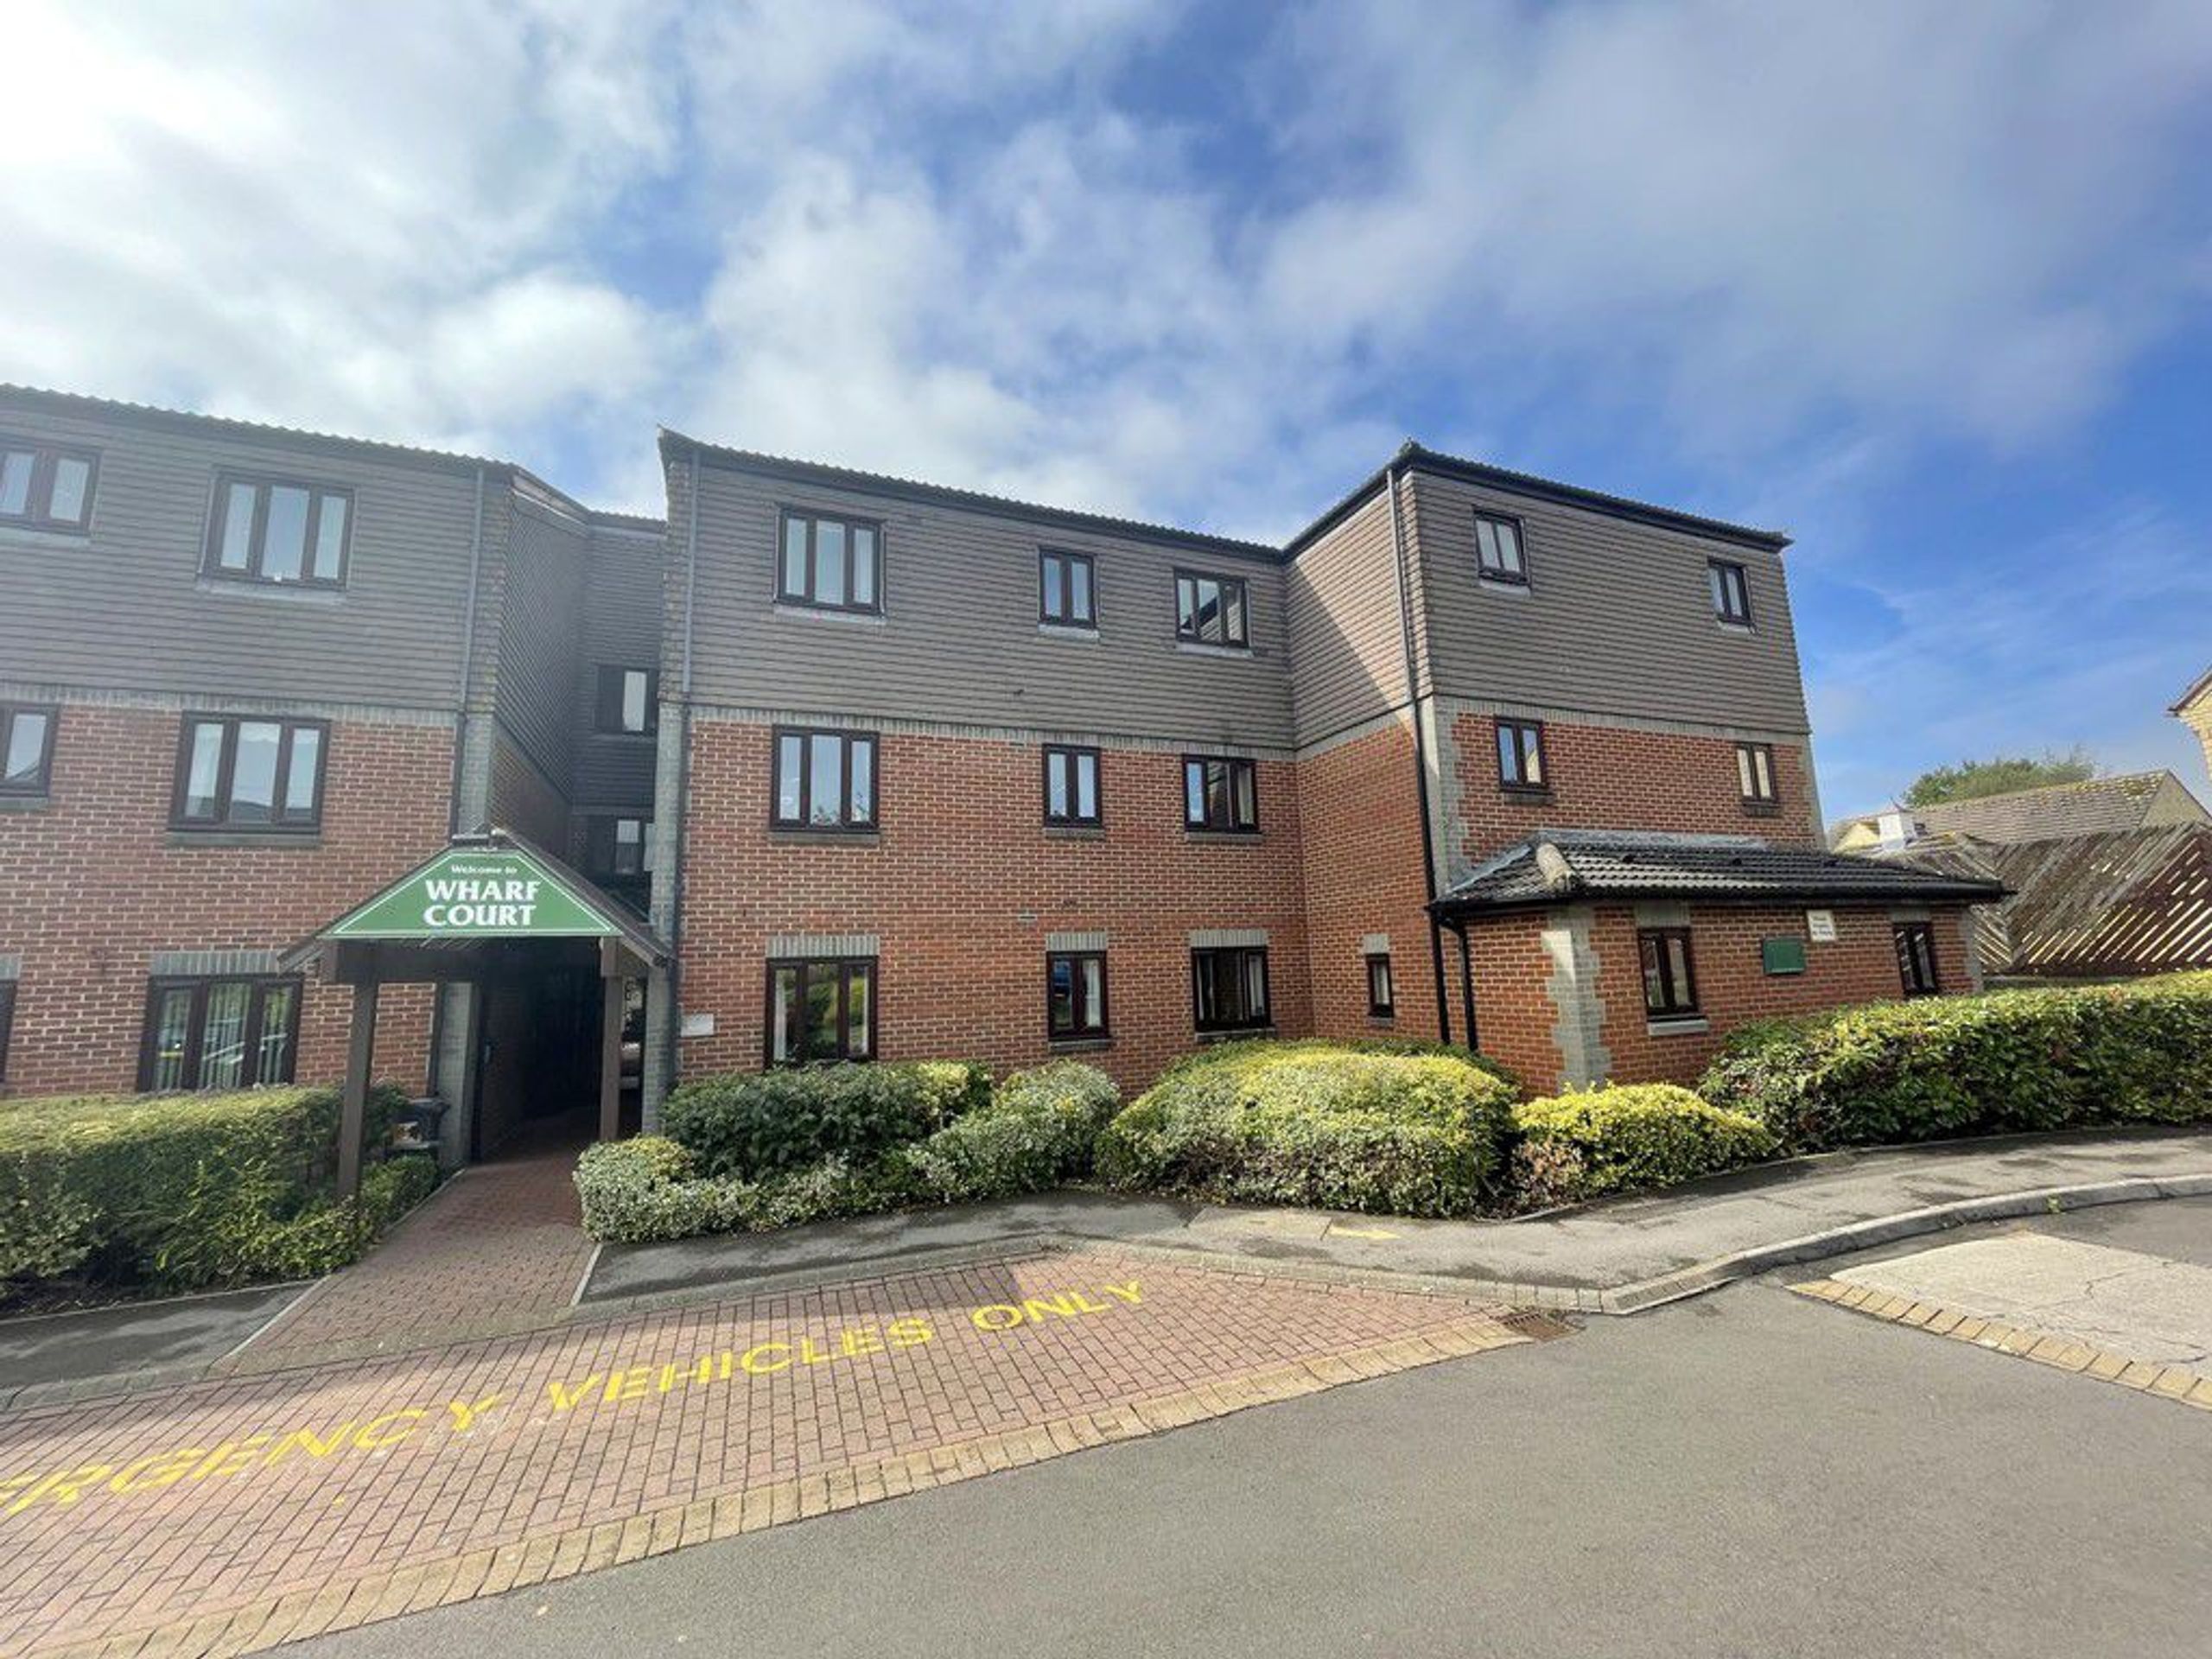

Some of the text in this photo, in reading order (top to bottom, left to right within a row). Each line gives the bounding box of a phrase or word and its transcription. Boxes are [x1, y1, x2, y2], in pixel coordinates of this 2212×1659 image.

[451, 865, 502, 874] Welcome
[425, 879, 542, 901] WHARF
[423, 904, 537, 926] COURT
[548, 1317, 934, 1412] VEHICLES
[969, 1280, 1143, 1334] ONLY
